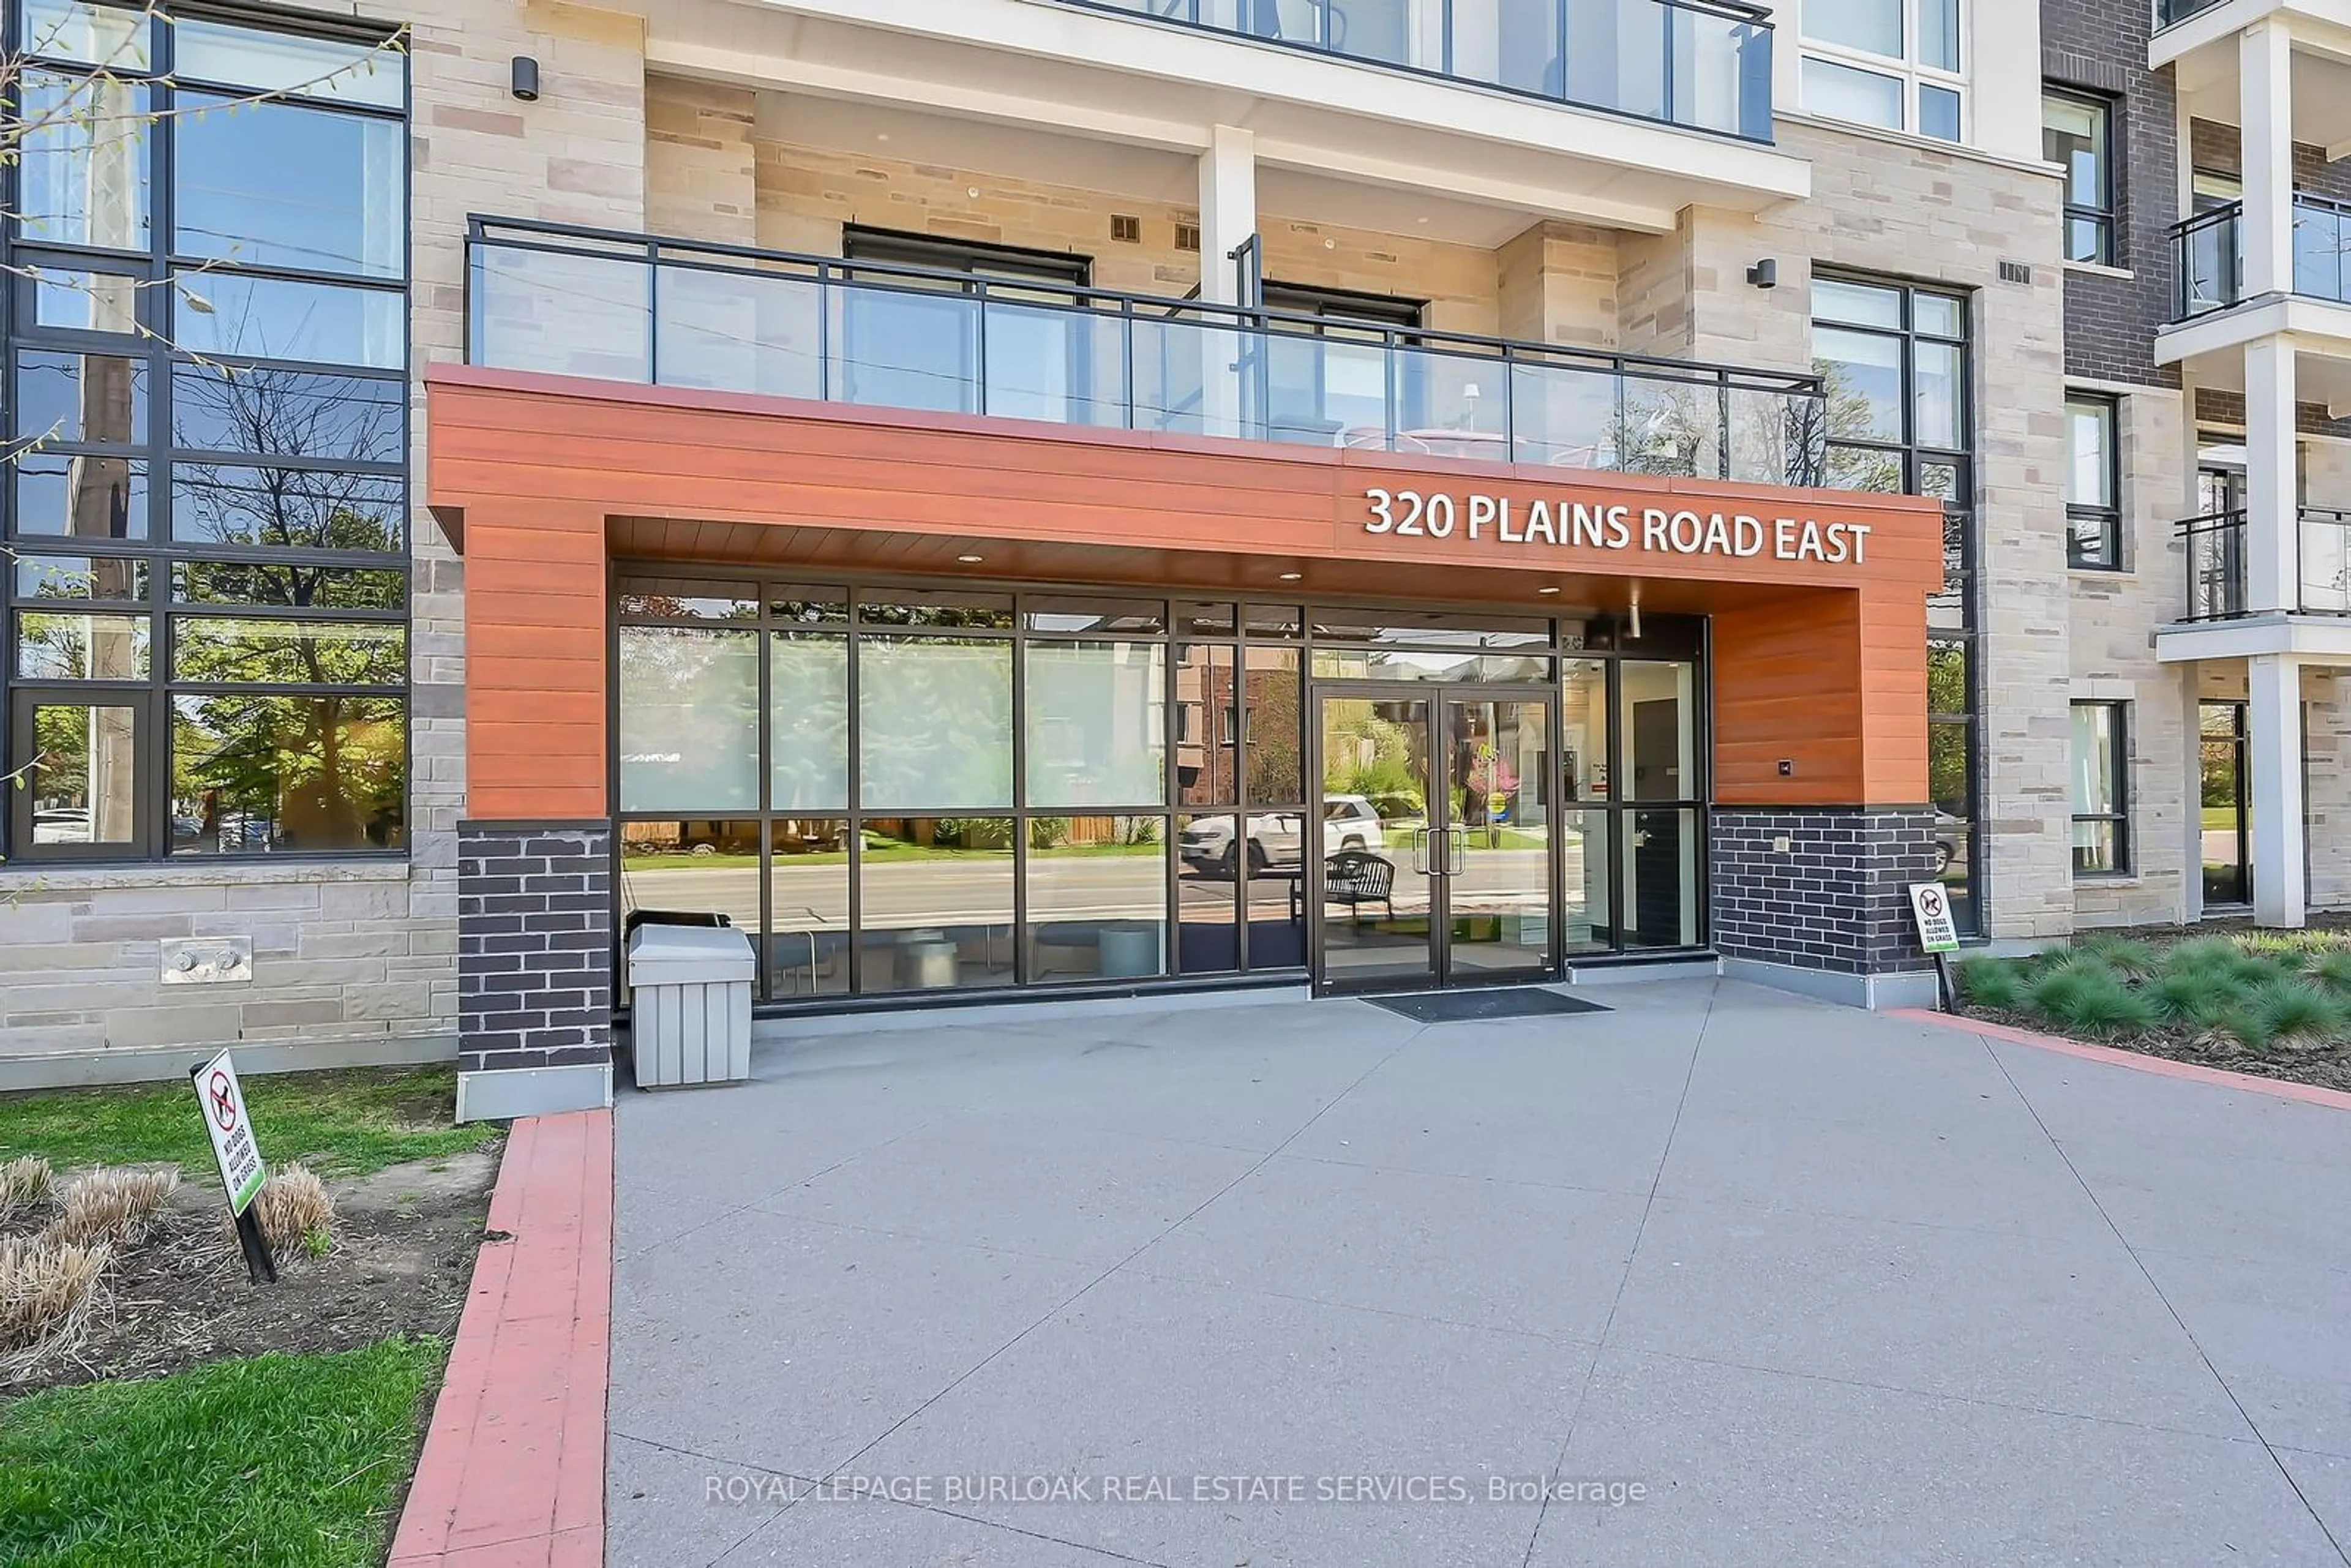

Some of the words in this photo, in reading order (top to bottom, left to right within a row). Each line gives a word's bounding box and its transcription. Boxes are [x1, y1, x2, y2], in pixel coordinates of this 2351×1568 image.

[1365, 489, 1455, 539] 320
[1469, 495, 1630, 549] PLAINS
[1643, 508, 1763, 558] ROAD
[1775, 518, 1871, 564] EAST
[223, 1139, 233, 1156] NO
[231, 1124, 246, 1147] DOGS
[229, 1140, 250, 1172] ALLOWED
[233, 1175, 242, 1191] ON
[241, 1155, 257, 1182] GRASS
